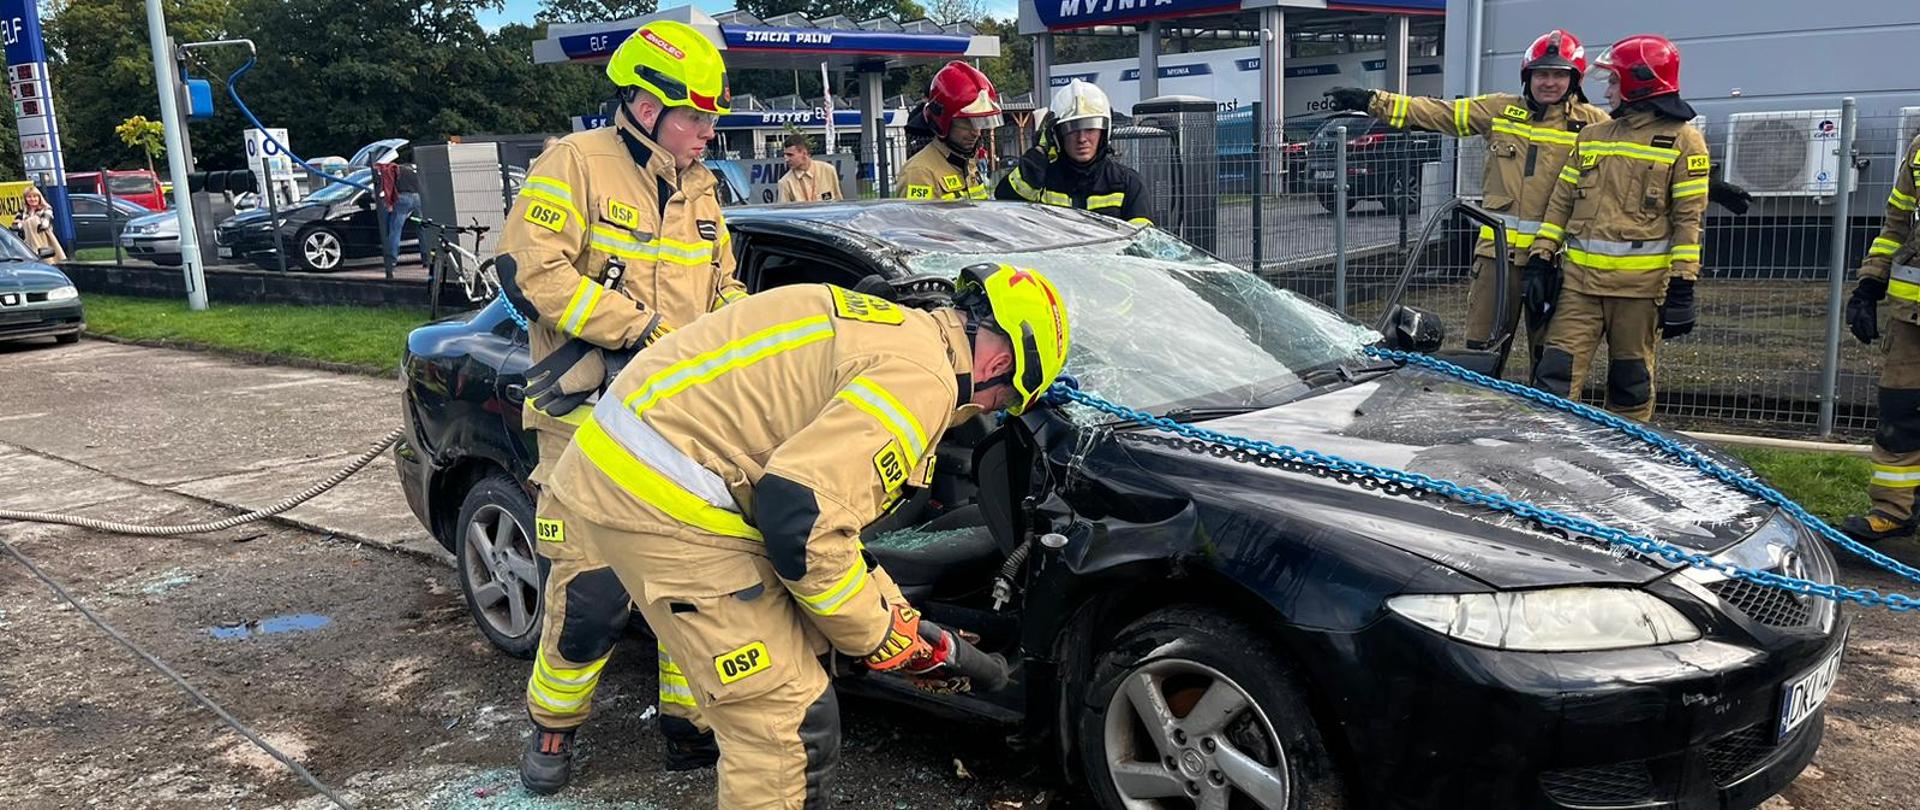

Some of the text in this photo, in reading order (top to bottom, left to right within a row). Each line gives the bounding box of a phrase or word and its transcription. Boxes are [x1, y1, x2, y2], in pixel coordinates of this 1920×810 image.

[1, 17, 22, 46] ELF
[745, 31, 832, 43] STACJA PALIW
[590, 35, 608, 52] ELF
[1166, 67, 1190, 75] MYJNIA
[1248, 61, 1259, 69] ELF
[1374, 61, 1385, 70] ELF
[762, 111, 811, 123] BISTRO
[1508, 106, 1525, 117] PSP
[1691, 158, 1707, 168] PSP
[911, 187, 929, 198] PSP
[530, 204, 561, 225] OSP
[611, 204, 633, 223] OSP
[880, 450, 903, 483] OSP
[538, 522, 558, 538] OSP
[722, 648, 760, 677] OSP
